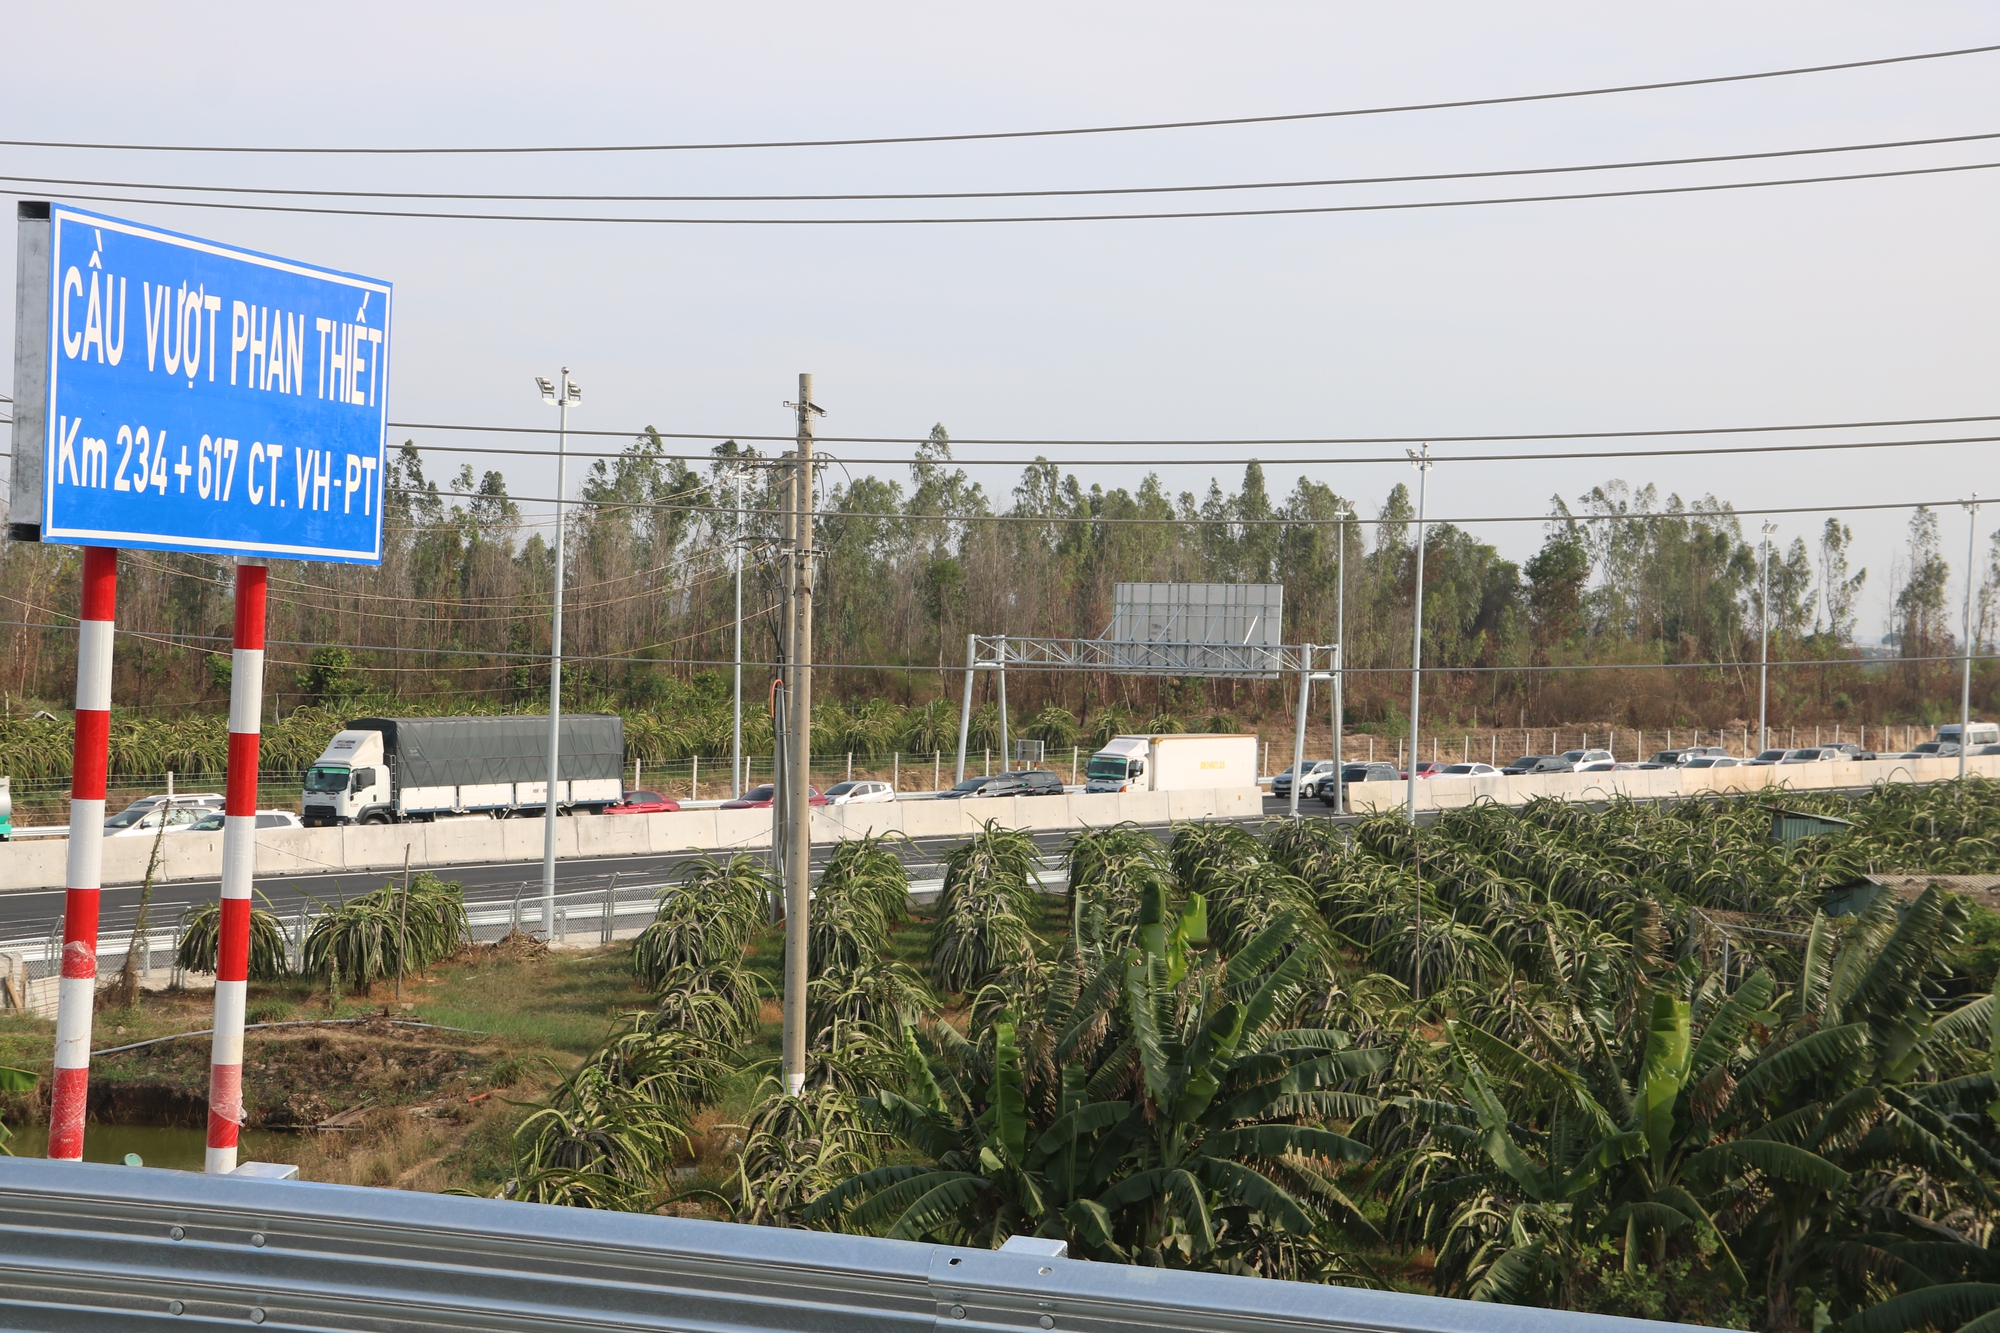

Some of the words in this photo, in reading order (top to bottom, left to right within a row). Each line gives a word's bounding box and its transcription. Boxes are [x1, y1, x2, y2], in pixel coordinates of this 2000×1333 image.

[62, 229, 126, 366] CẦU
[144, 280, 221, 388] VƯỢT
[231, 300, 304, 396] PHAN
[316, 292, 382, 407] THIẾT
[58, 416, 107, 489] Km
[248, 442, 286, 508] CT.
[296, 447, 376, 515] VH-PT
